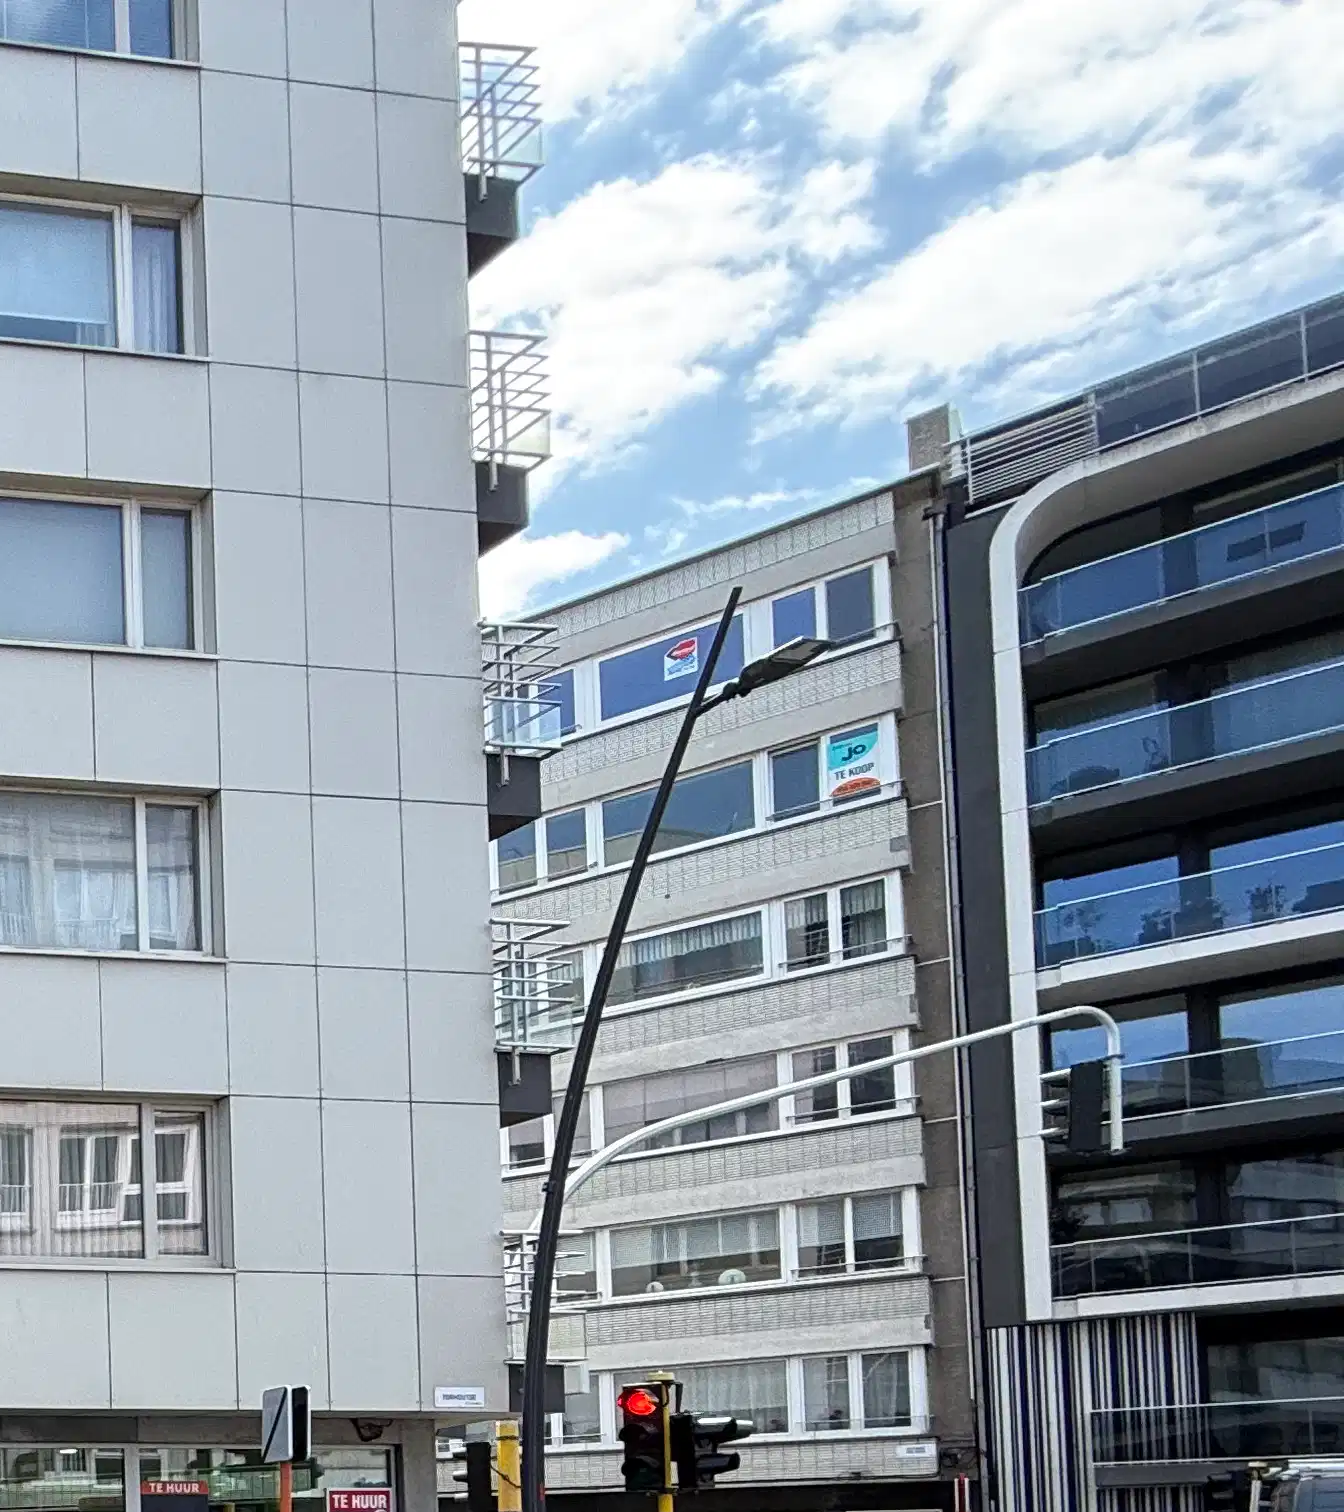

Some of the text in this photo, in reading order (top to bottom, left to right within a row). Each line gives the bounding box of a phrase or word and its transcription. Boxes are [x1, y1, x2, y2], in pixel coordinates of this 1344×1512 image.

[834, 762, 874, 780] TE KOOP
[149, 1483, 200, 1493] TE HUUR
[332, 1494, 388, 1509] TE HUUR
